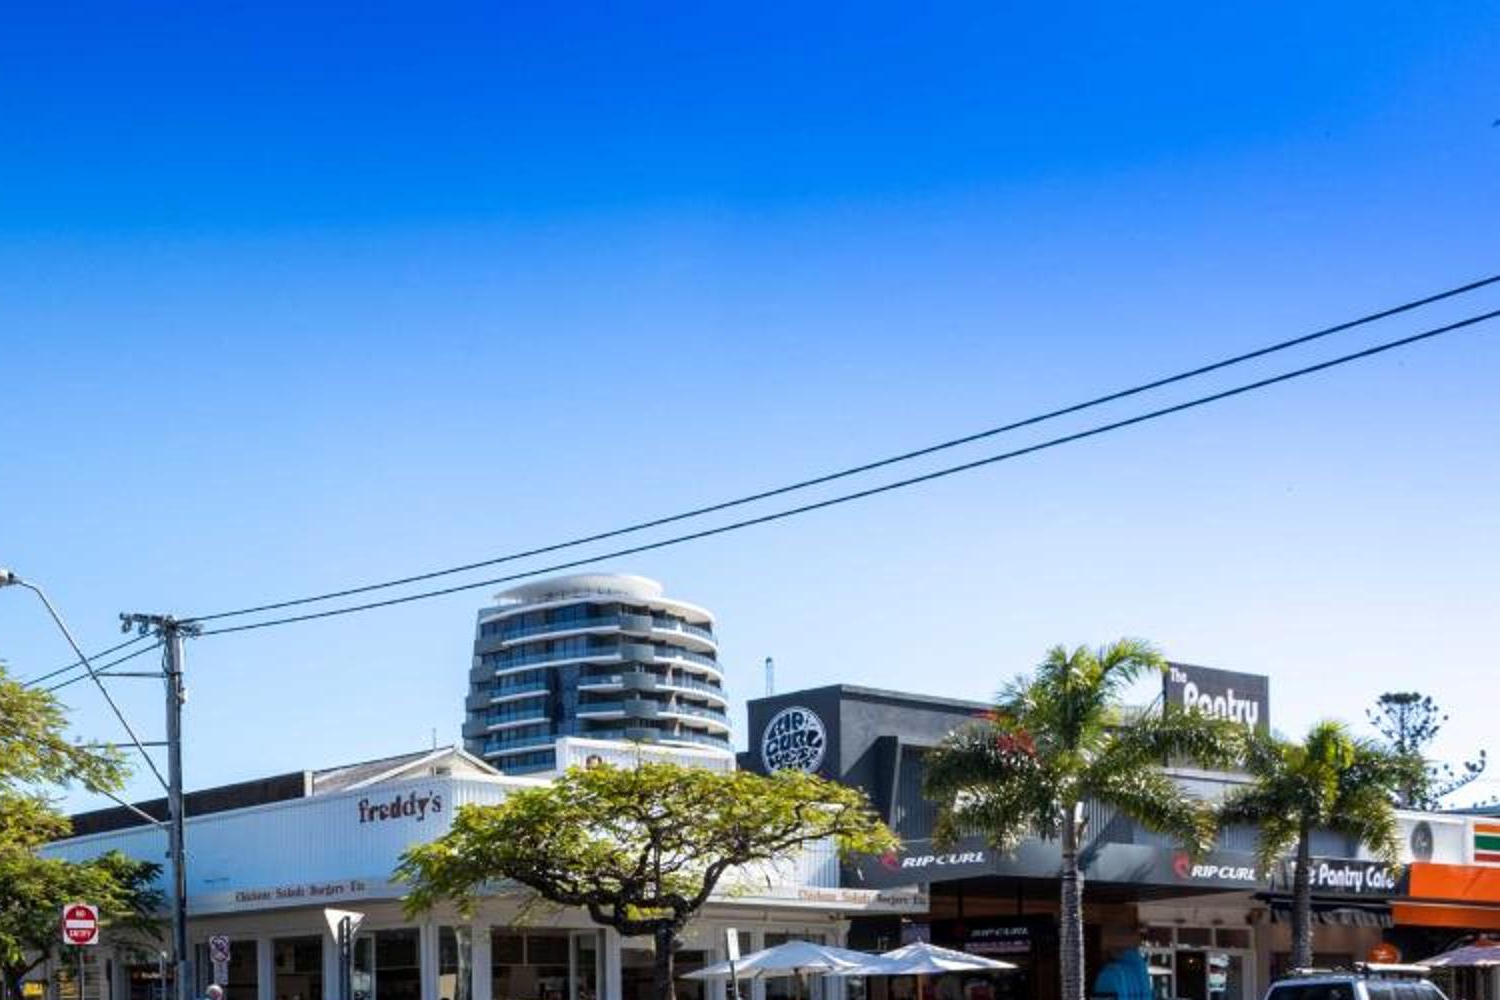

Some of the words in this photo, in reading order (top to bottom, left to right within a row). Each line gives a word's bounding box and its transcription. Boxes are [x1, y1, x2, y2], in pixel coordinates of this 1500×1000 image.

[1170, 667, 1187, 683] The
[1183, 682, 1259, 734] Pantry
[765, 729, 823, 757] CURL
[358, 790, 442, 823] freddy's
[902, 855, 935, 868] RIP
[935, 851, 986, 865] CURL
[1191, 864, 1219, 877] RIP
[1218, 866, 1256, 881] CURL
[1319, 863, 1362, 892] Pantry
